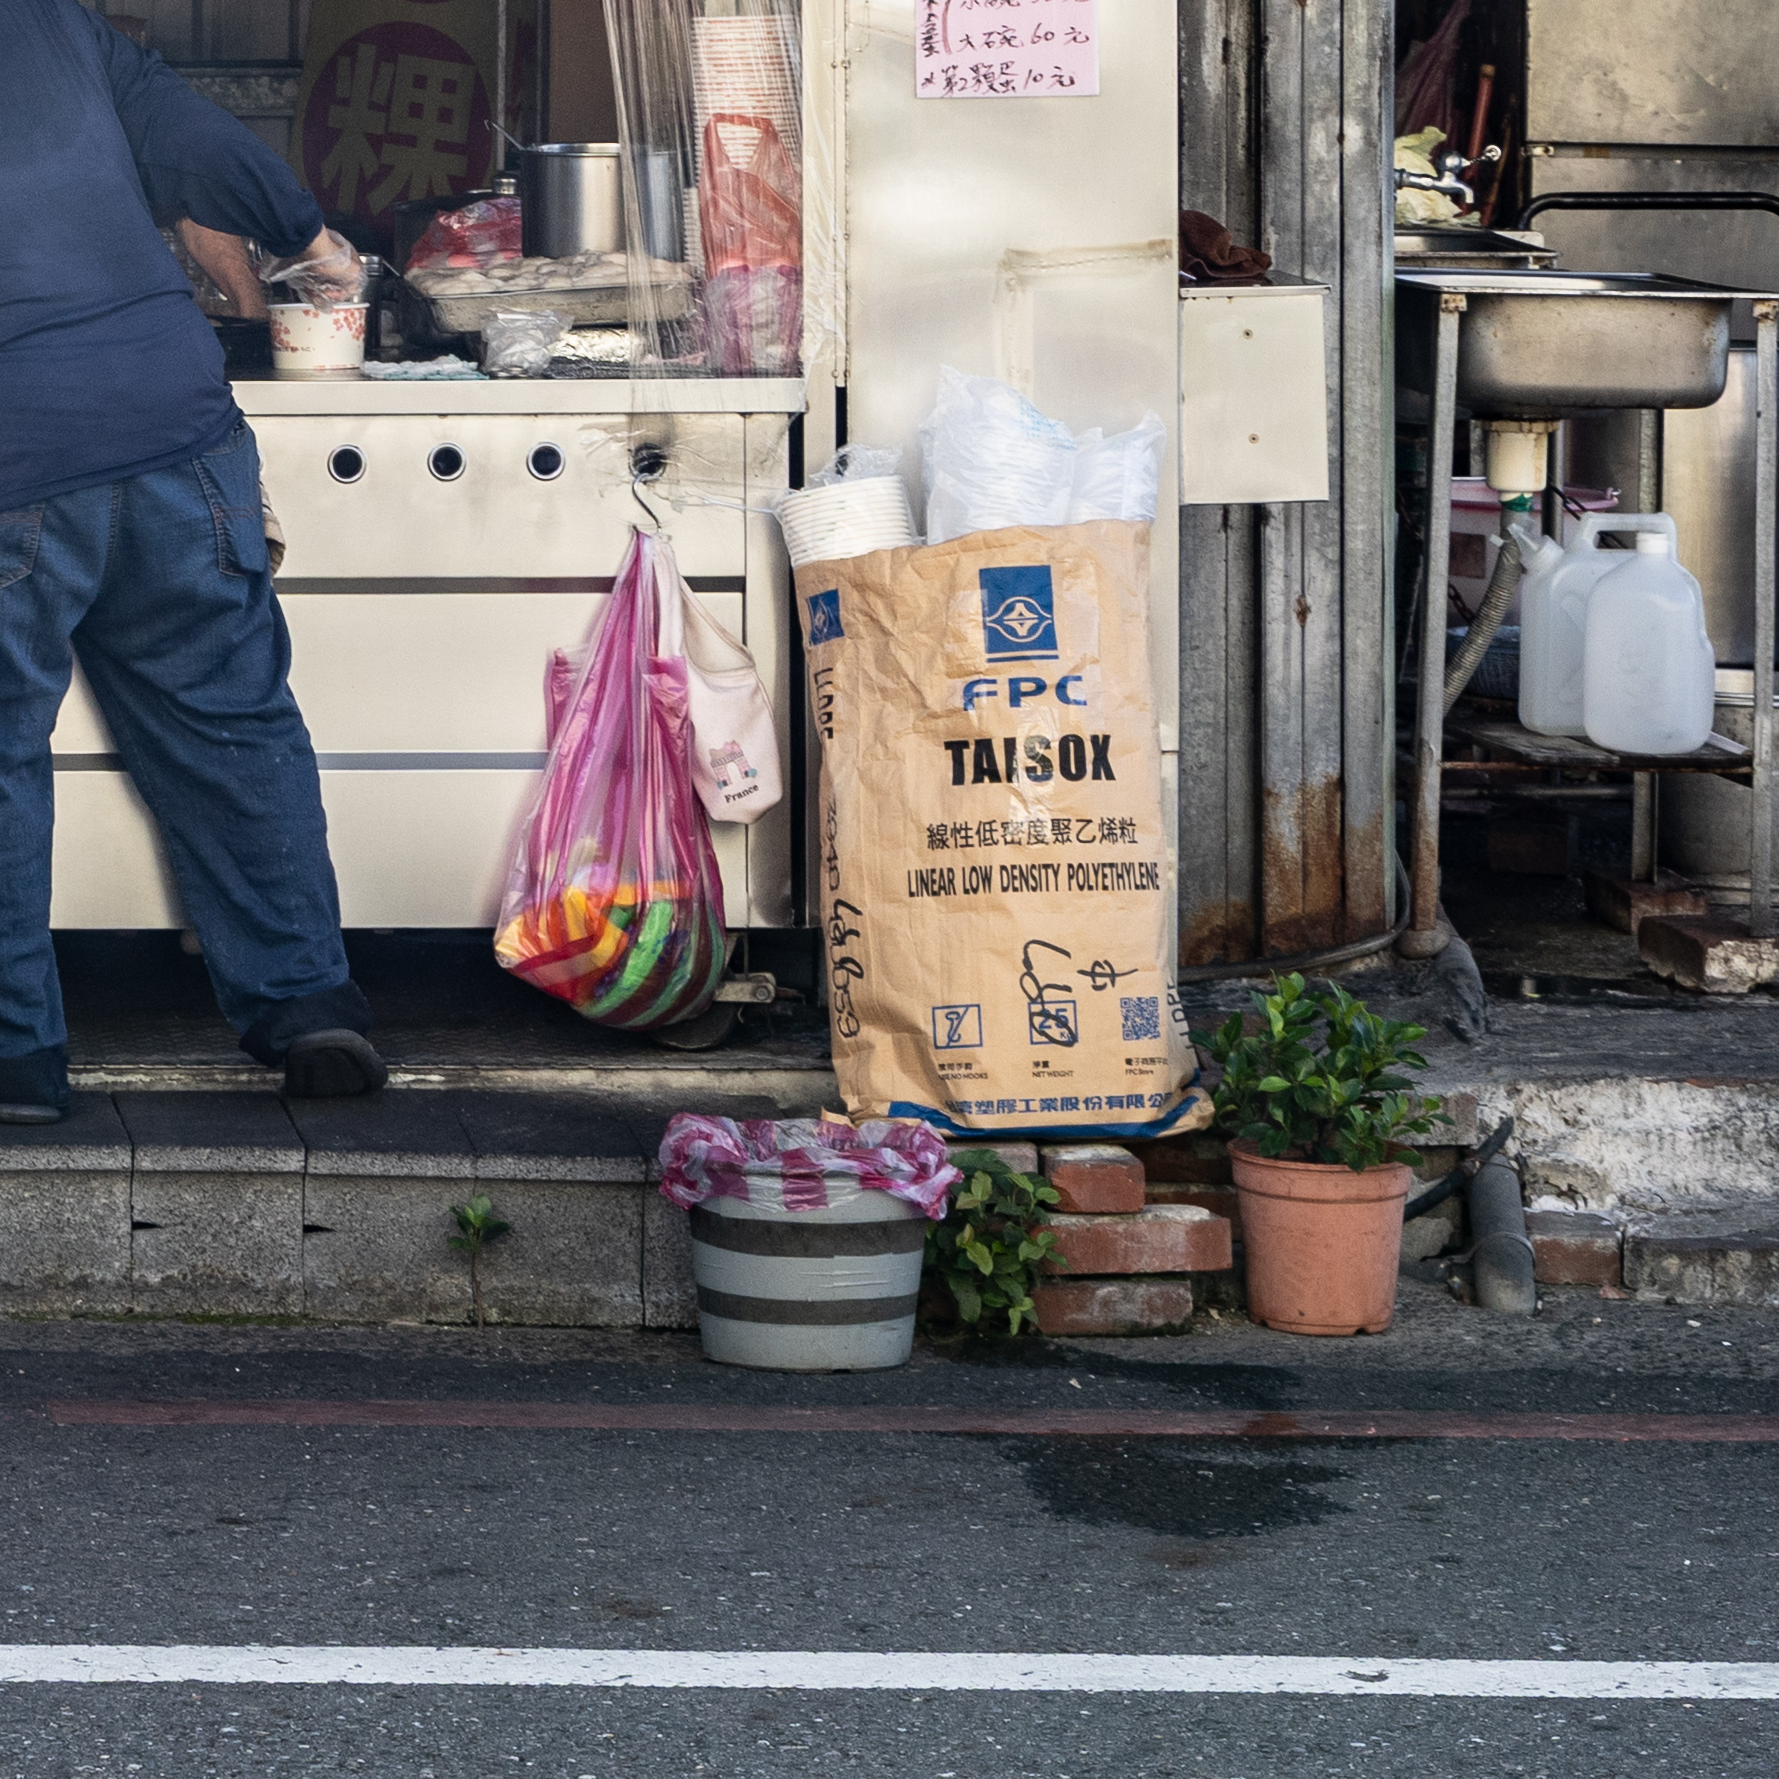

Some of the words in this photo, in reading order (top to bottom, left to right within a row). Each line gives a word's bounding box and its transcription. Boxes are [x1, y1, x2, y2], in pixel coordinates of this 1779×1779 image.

[961, 675, 1088, 712] FPC
[944, 733, 1117, 787] TAISOX
[723, 782, 760, 805] France
[926, 817, 1140, 850] 線性低密度聚乙烯粒
[907, 867, 957, 898] LINEAR
[962, 865, 993, 895] LOW
[1000, 863, 1061, 893] DENSITY
[1068, 861, 1161, 892] POLYETHYLENE
